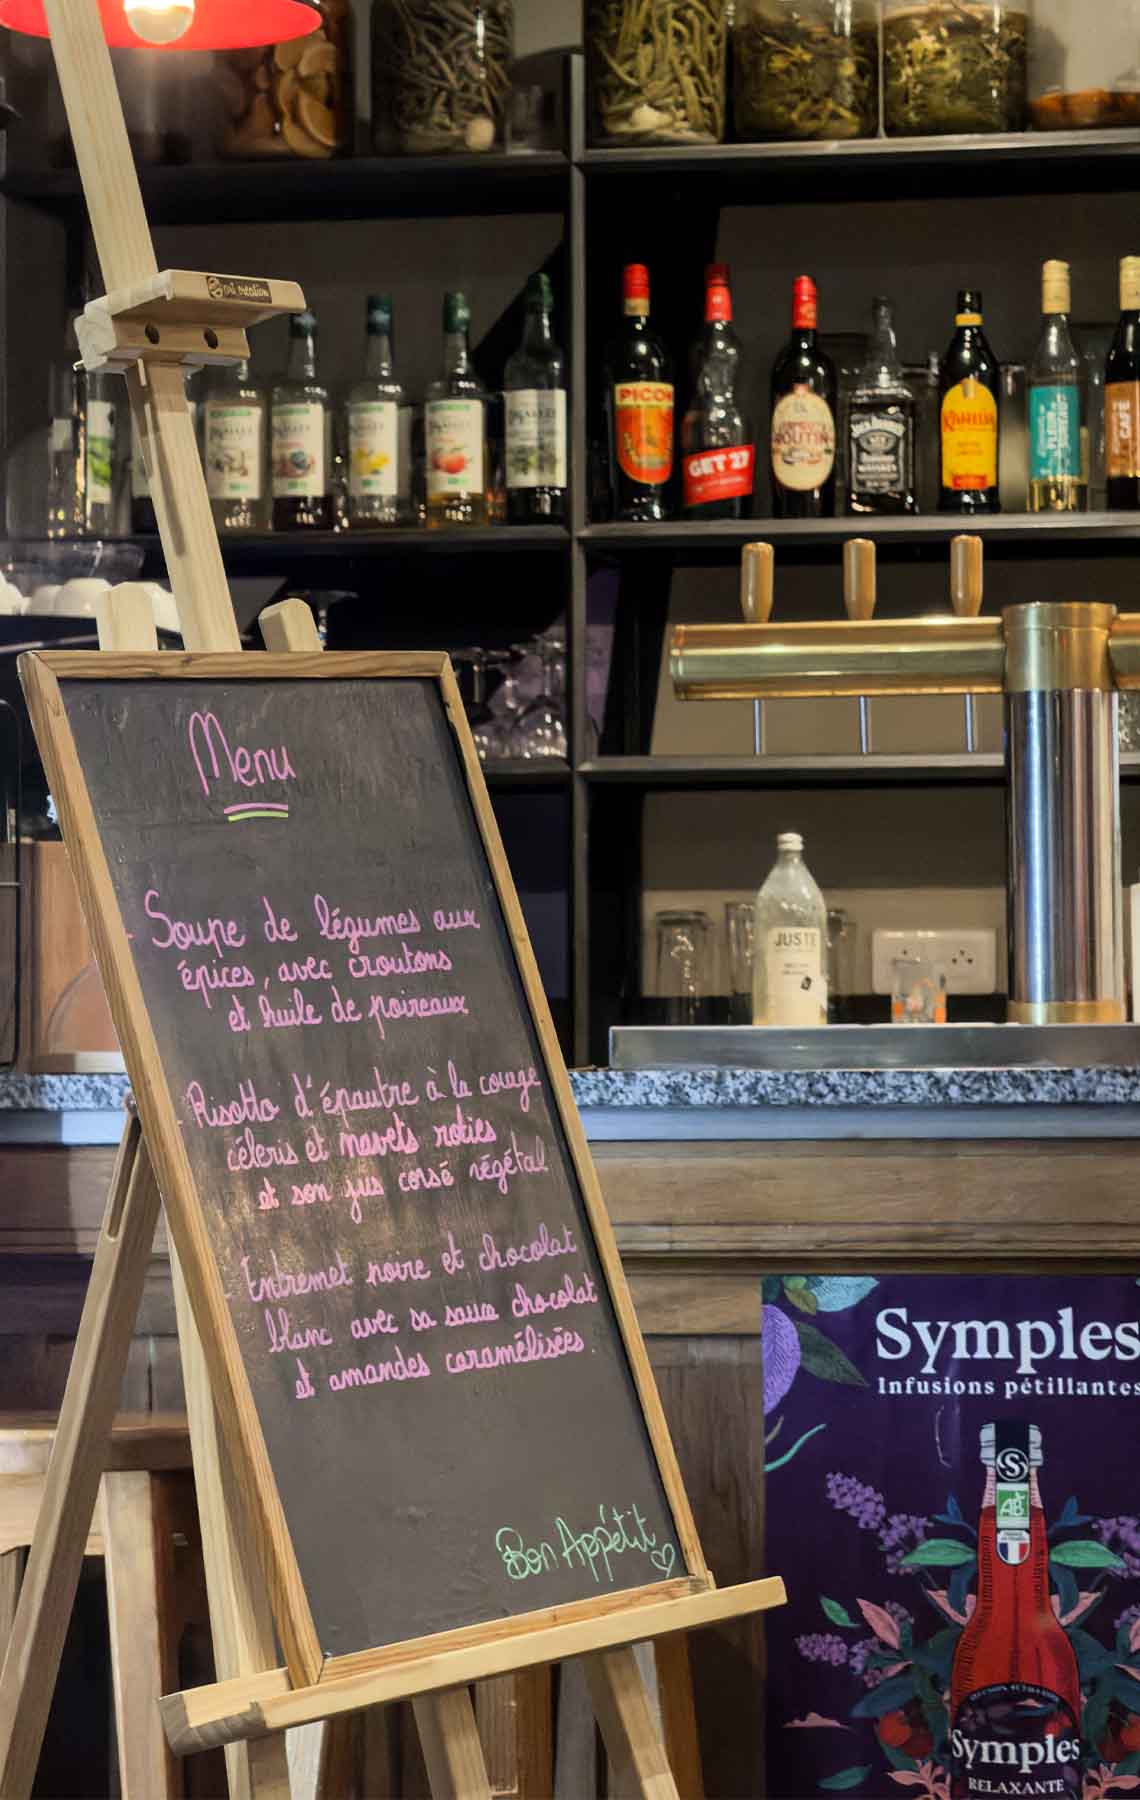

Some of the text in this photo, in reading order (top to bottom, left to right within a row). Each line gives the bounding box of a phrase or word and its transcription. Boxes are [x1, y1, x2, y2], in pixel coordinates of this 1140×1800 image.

[688, 450, 750, 477] GET 27
[188, 711, 297, 796] Menu
[144, 889, 481, 958] Soupe de légumes aux
[277, 955, 333, 983] avec
[348, 942, 452, 978] croutons
[228, 985, 469, 1040] et huile de poireaux
[185, 1079, 280, 1129] Risotto
[425, 1065, 447, 1100] à
[448, 1059, 472, 1099] la
[305, 1125, 329, 1163] et
[258, 1130, 549, 1225] et son jus corsé végétal
[240, 1249, 353, 1302] Entremet
[441, 1230, 465, 1275] et
[478, 1222, 578, 1272] chocolat
[264, 1272, 599, 1353] blanc avec sa sauce chocolat
[875, 1306, 1140, 1375] Symples
[295, 1357, 315, 1400] et
[328, 1345, 431, 1391] amandes
[878, 1376, 1140, 1399] Infusions pétillantes
[495, 1503, 657, 1584] Bon Appétit
[952, 1728, 1081, 1775] Symples
[967, 1776, 1065, 1796] RELAXANTE
